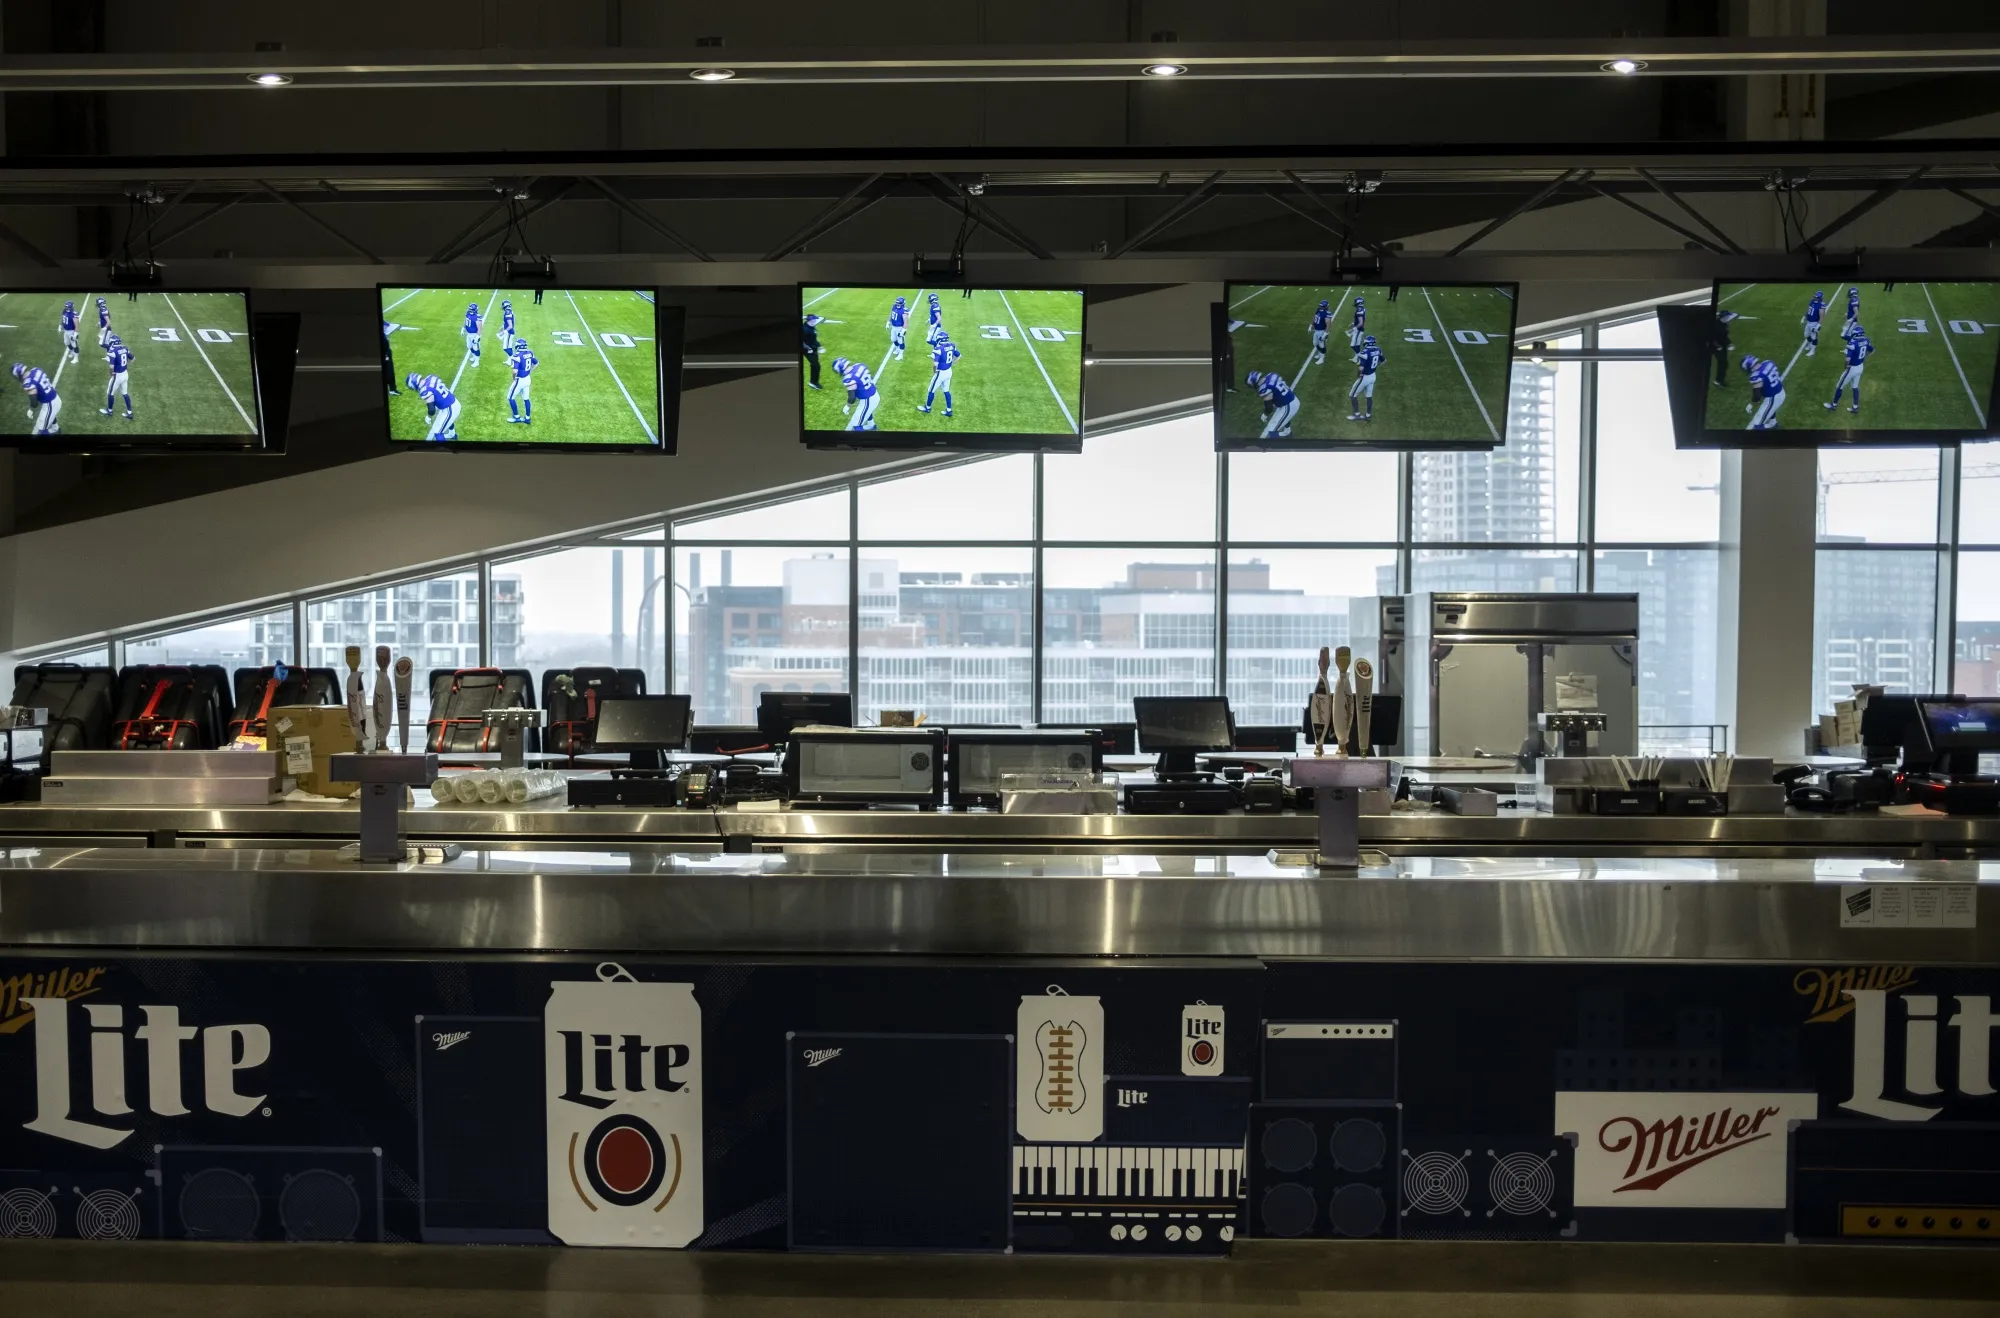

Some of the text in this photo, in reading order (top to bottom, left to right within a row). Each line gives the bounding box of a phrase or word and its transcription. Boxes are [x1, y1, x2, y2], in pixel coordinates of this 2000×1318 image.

[1186, 1017, 1221, 1039] Lite
[432, 1030, 470, 1051] Miller
[803, 1047, 843, 1067] Miller
[19, 997, 272, 1149] Lite
[558, 1030, 689, 1109] Lite
[1117, 1088, 1148, 1107] Lite
[1599, 1105, 1780, 1193] Miller
